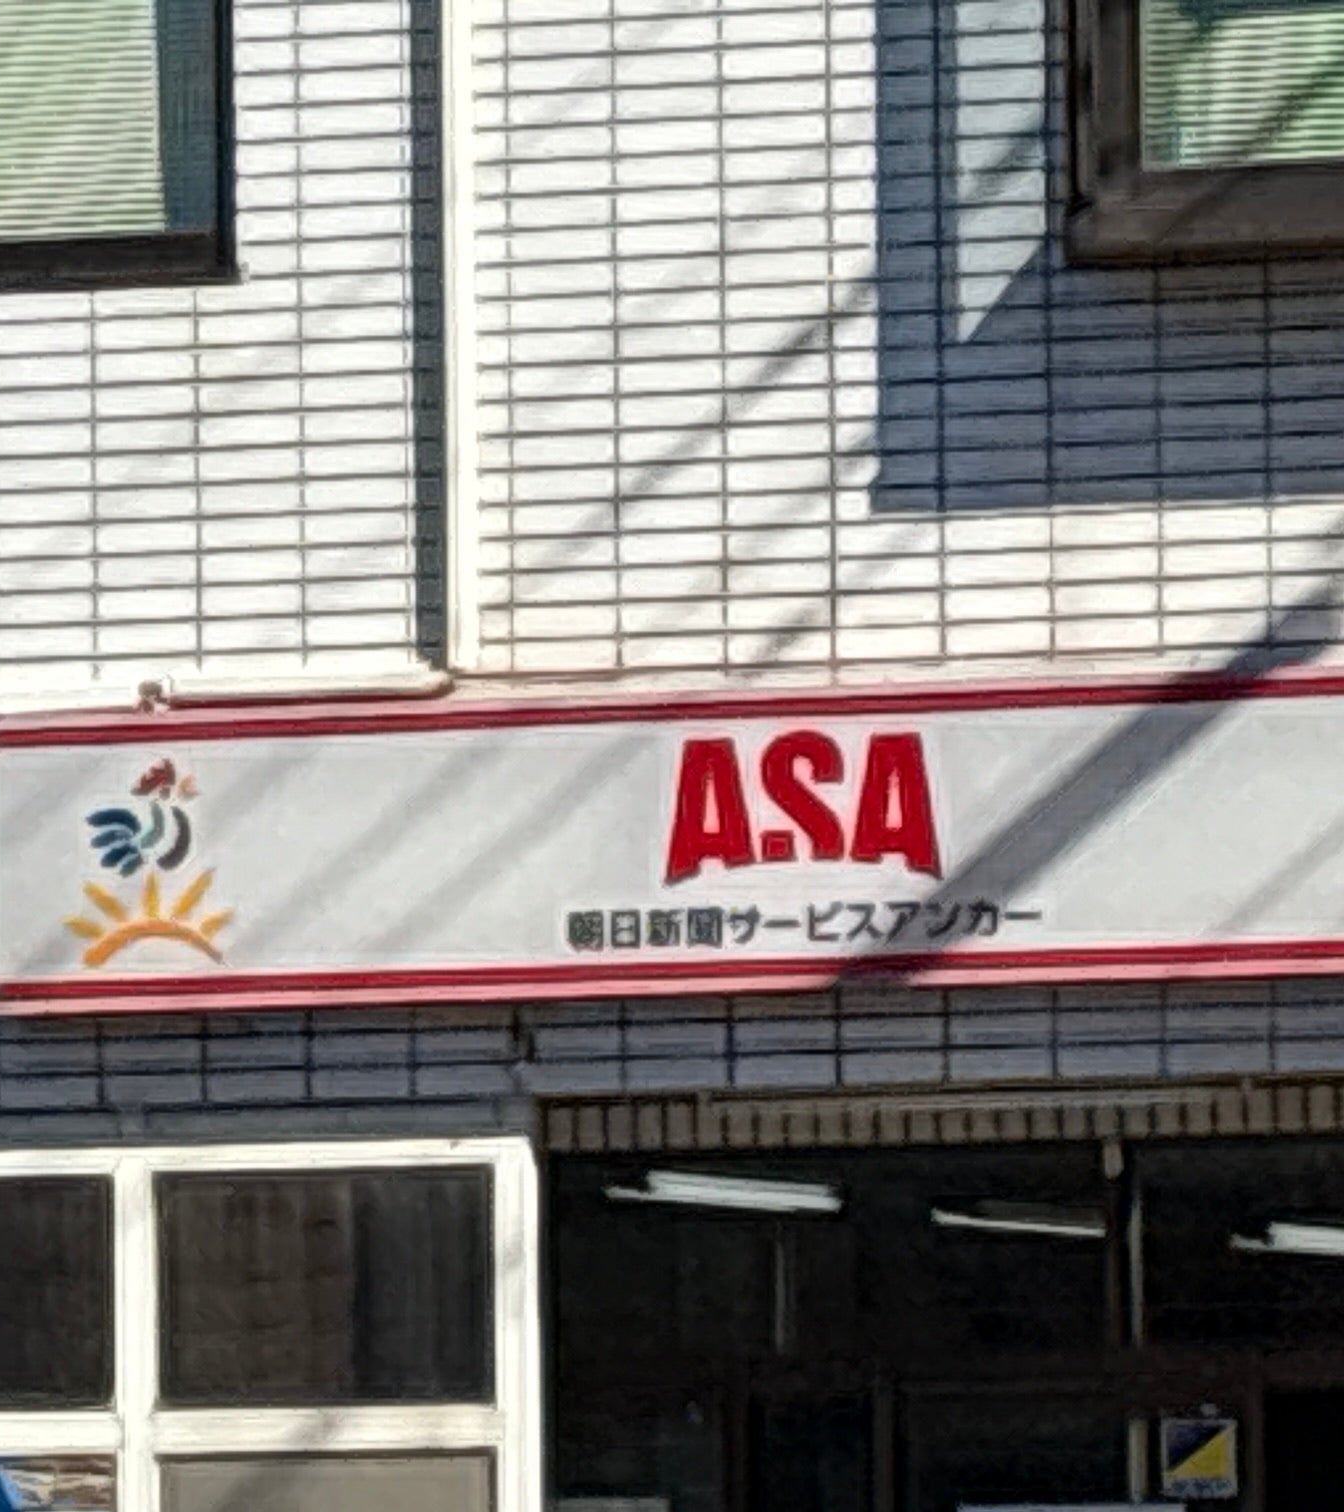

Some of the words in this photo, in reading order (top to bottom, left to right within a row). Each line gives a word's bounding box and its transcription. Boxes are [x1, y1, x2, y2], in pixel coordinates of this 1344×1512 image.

[662, 729, 943, 886] ASA
[566, 900, 1043, 951] 朝日新聞サービスアンカー
